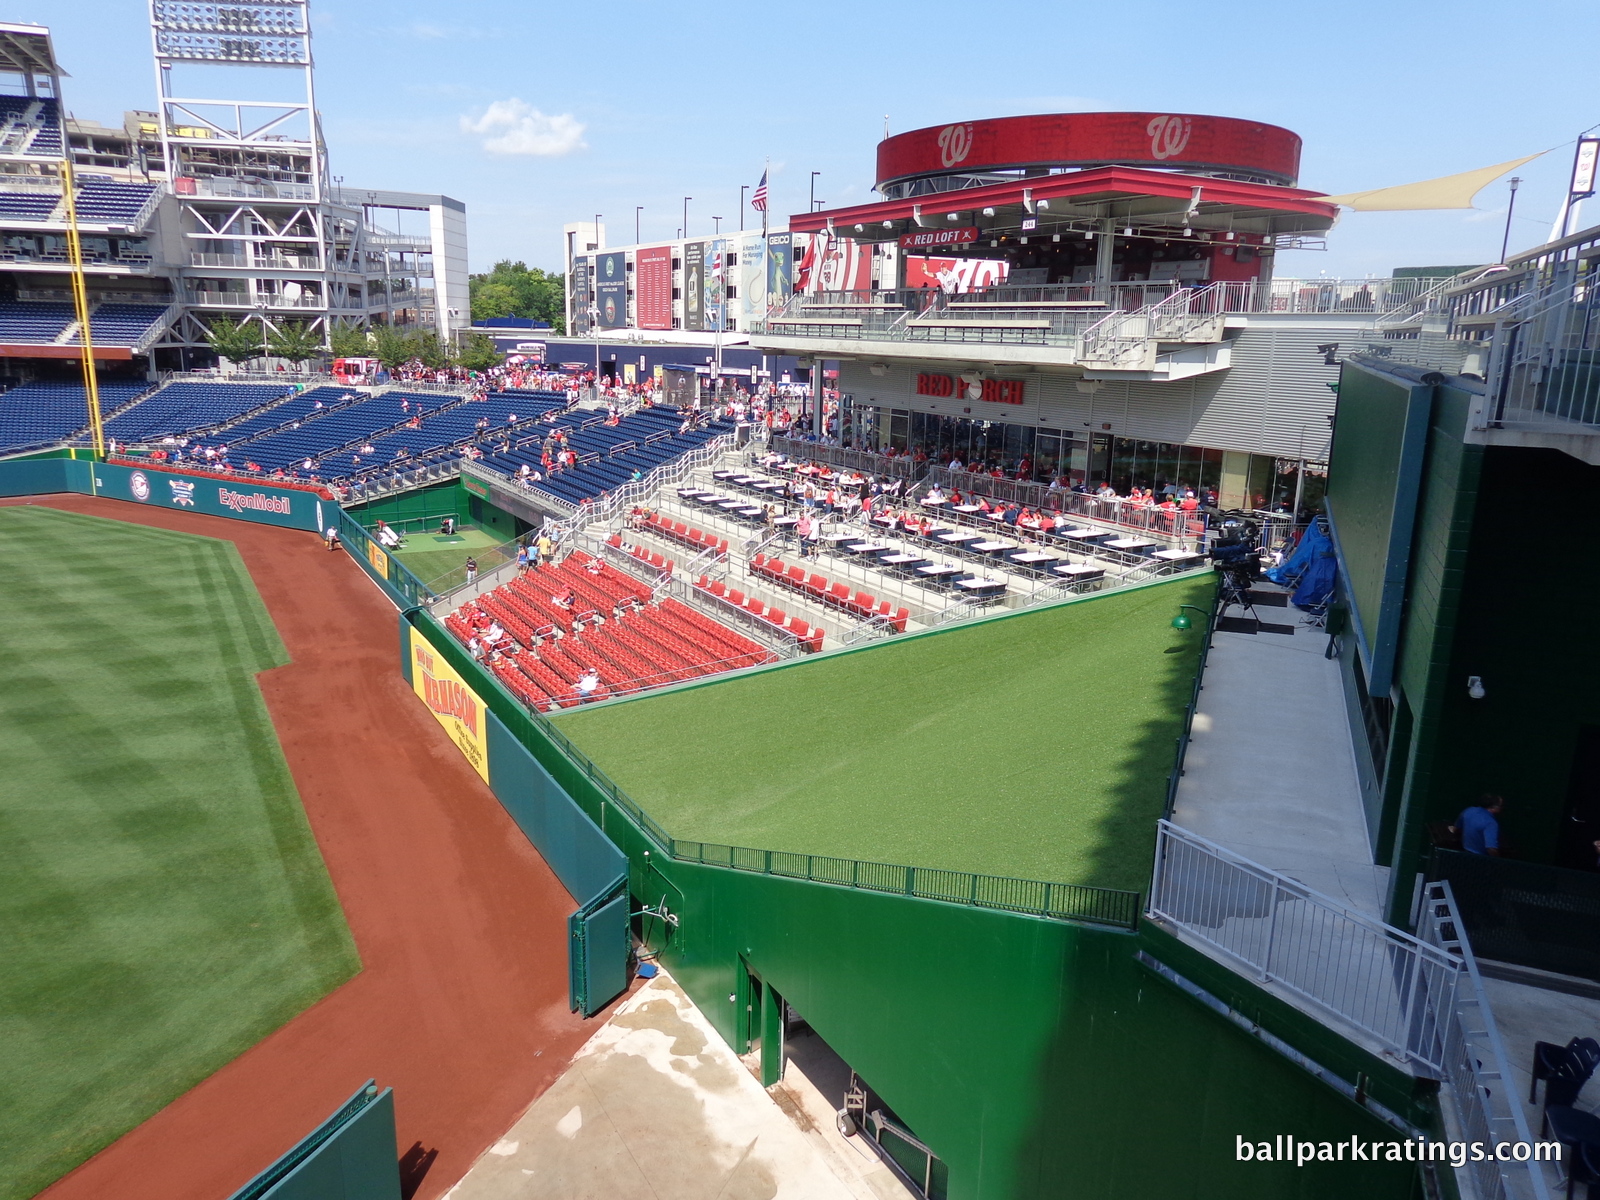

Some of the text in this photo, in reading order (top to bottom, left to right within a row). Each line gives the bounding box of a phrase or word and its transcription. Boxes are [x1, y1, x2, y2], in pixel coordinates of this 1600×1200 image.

[769, 235, 790, 245] GEICO
[914, 230, 960, 245] RED LOFT
[916, 374, 951, 397] RED
[219, 488, 290, 513] ExxonMobil
